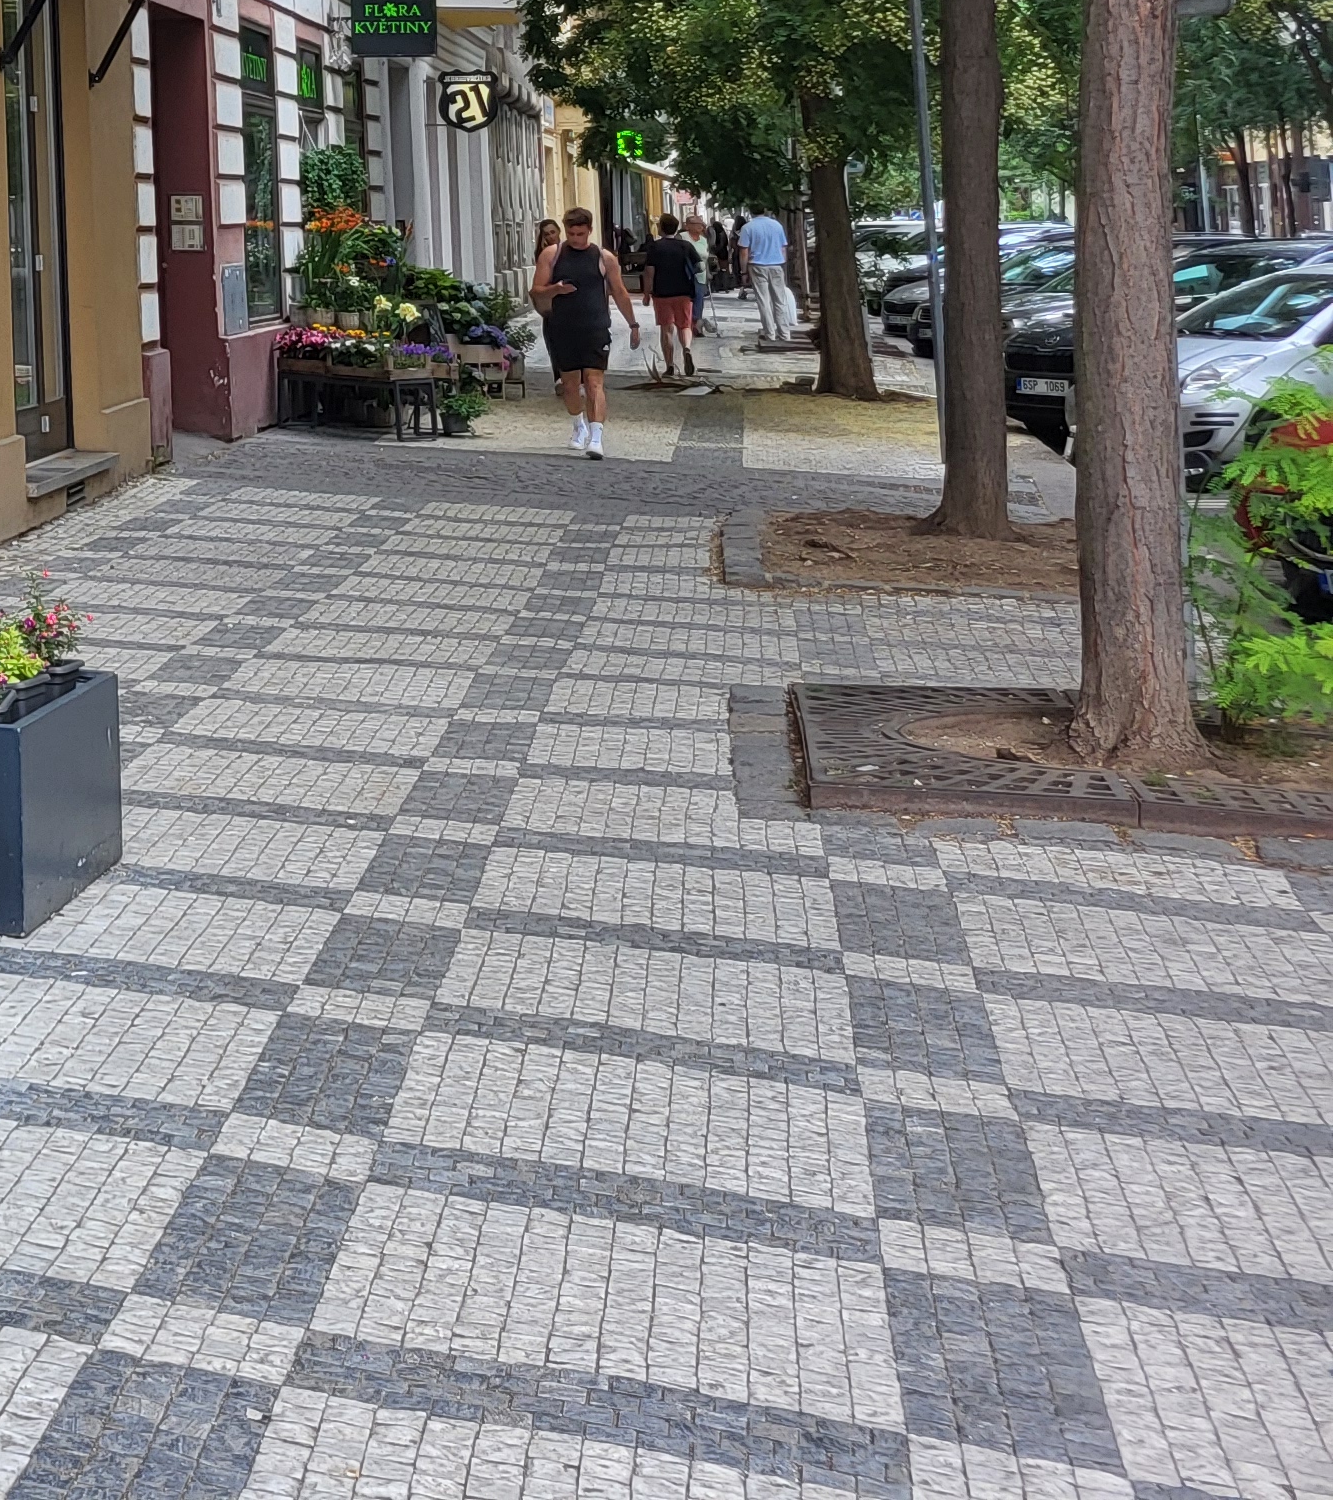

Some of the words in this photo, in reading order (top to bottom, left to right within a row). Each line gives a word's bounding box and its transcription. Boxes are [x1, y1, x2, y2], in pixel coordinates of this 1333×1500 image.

[354, 19, 433, 34] KVĚTINY
[448, 83, 490, 125] 21
[1044, 380, 1066, 393] 1069
